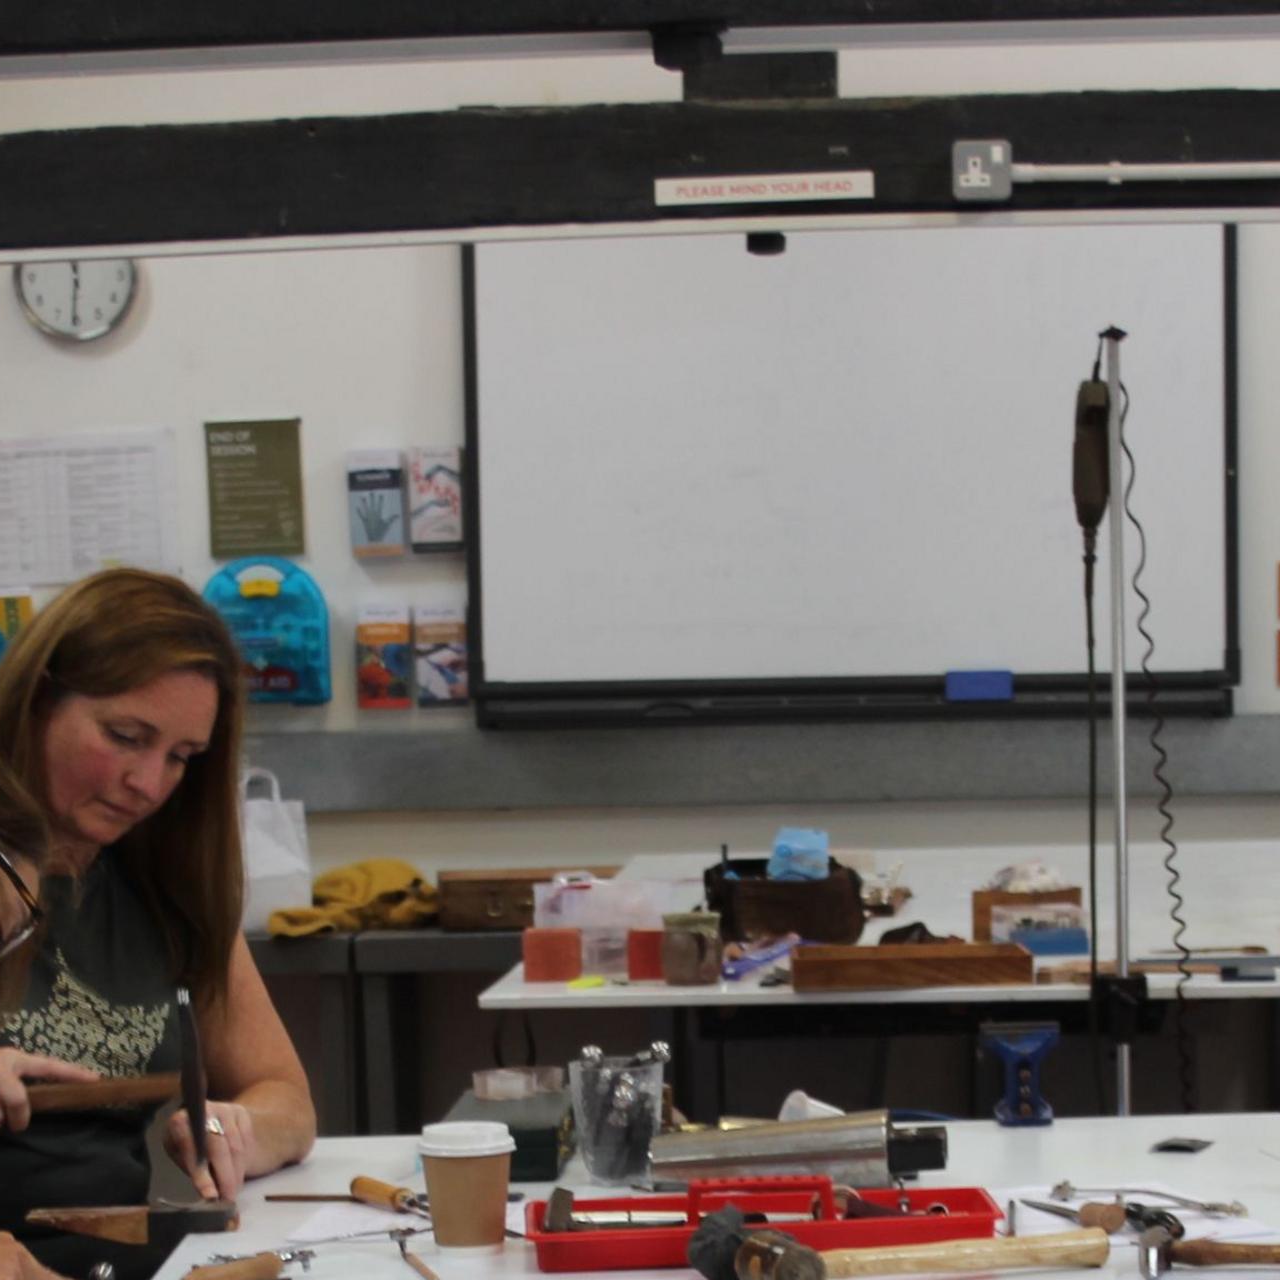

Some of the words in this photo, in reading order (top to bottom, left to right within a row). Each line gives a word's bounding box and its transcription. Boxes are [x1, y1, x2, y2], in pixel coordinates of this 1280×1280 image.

[675, 184, 725, 199] PLEASE
[729, 182, 768, 196] MIND
[772, 180, 810, 194] YOUR
[815, 180, 853, 193] HEAD
